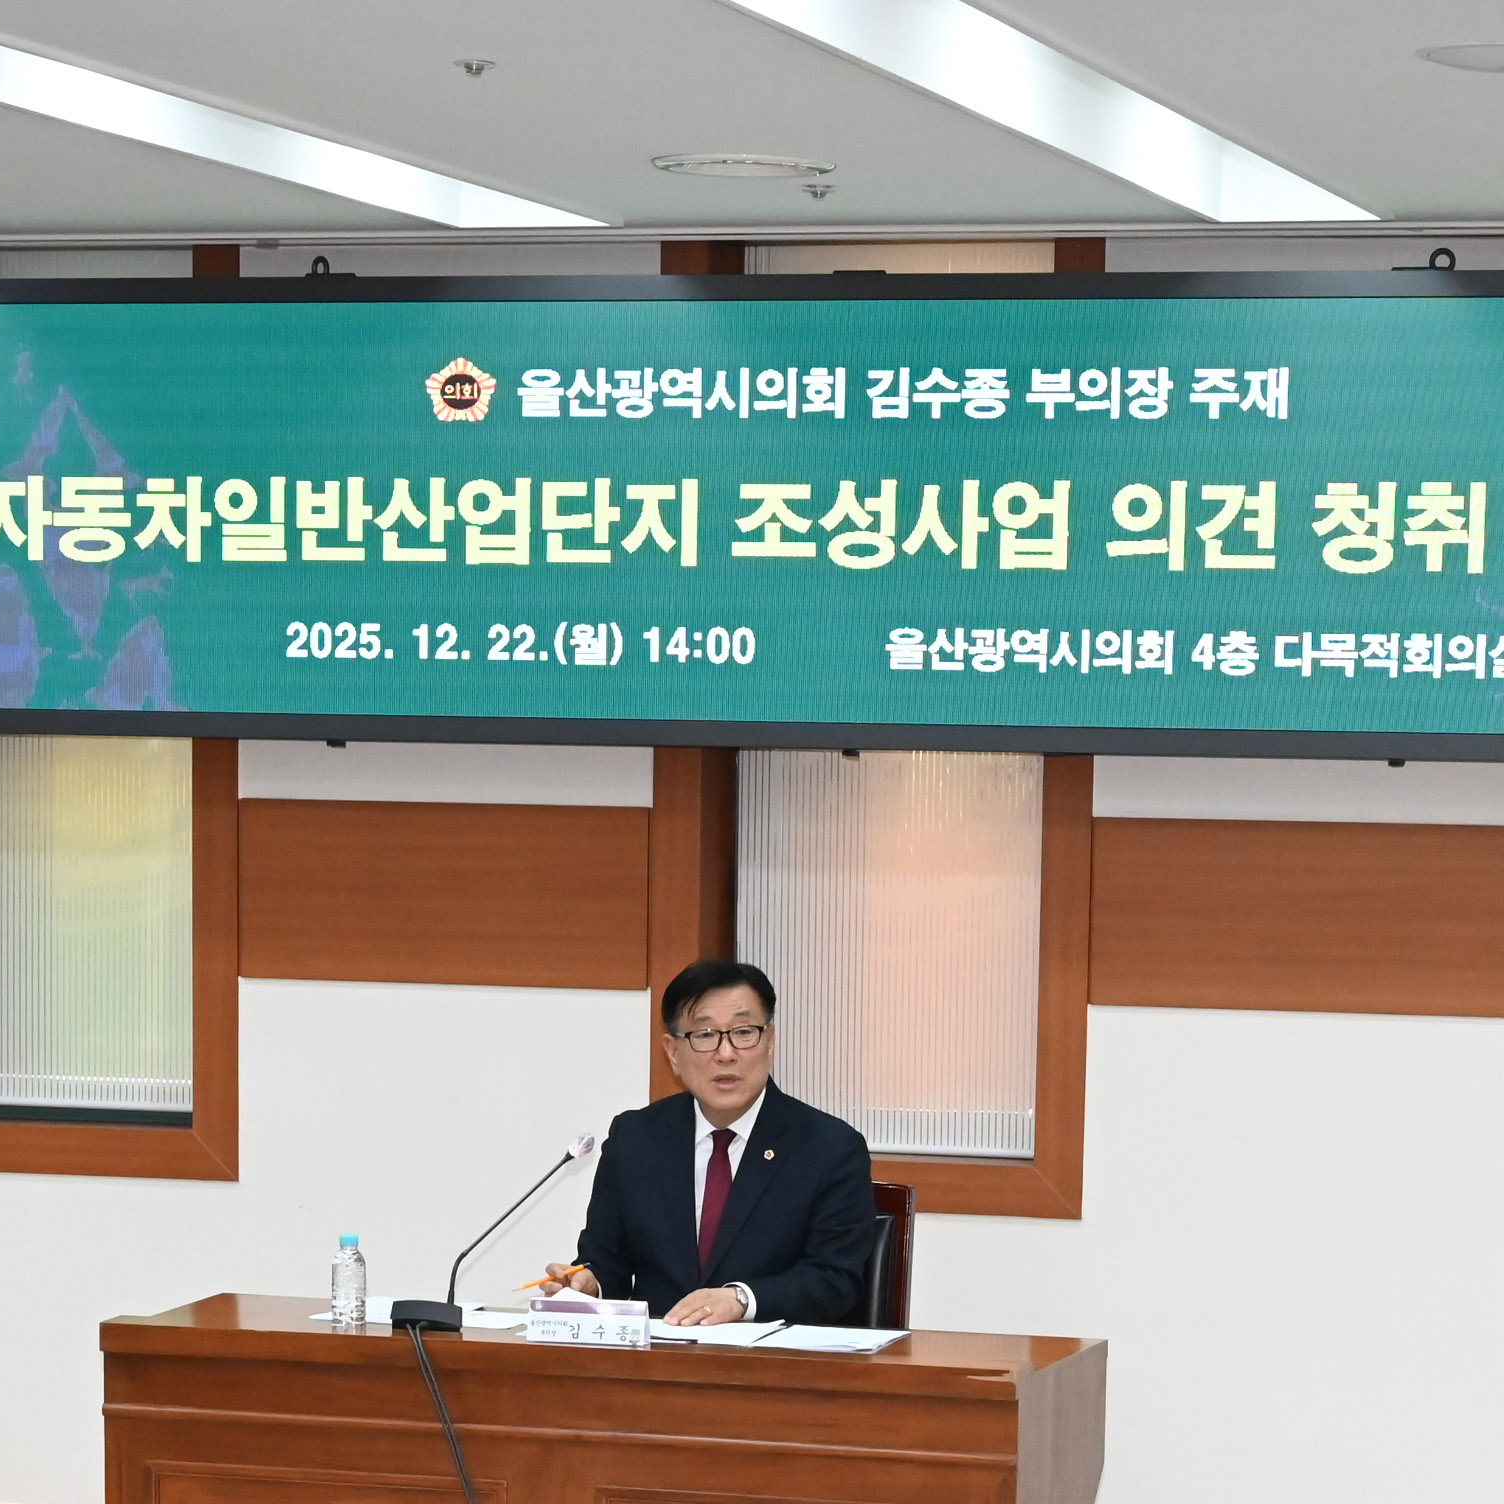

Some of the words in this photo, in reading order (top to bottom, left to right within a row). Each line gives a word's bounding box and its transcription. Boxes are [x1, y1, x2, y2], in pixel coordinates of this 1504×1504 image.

[517, 367, 846, 420] 울산광역시의회
[866, 367, 1011, 420] 김수종
[1025, 367, 1174, 420] 부의장
[1189, 367, 1291, 420] 주재
[731, 477, 1071, 571] 조성사업
[1105, 479, 1277, 572] 의견
[1311, 480, 1487, 575] 청취
[286, 620, 394, 661] 2025.
[412, 622, 472, 661] 12.
[487, 621, 624, 667] 22.(월)
[643, 625, 757, 666] 14:00
[885, 626, 1175, 676] 울산광역시의회
[1191, 629, 1260, 678] 4층
